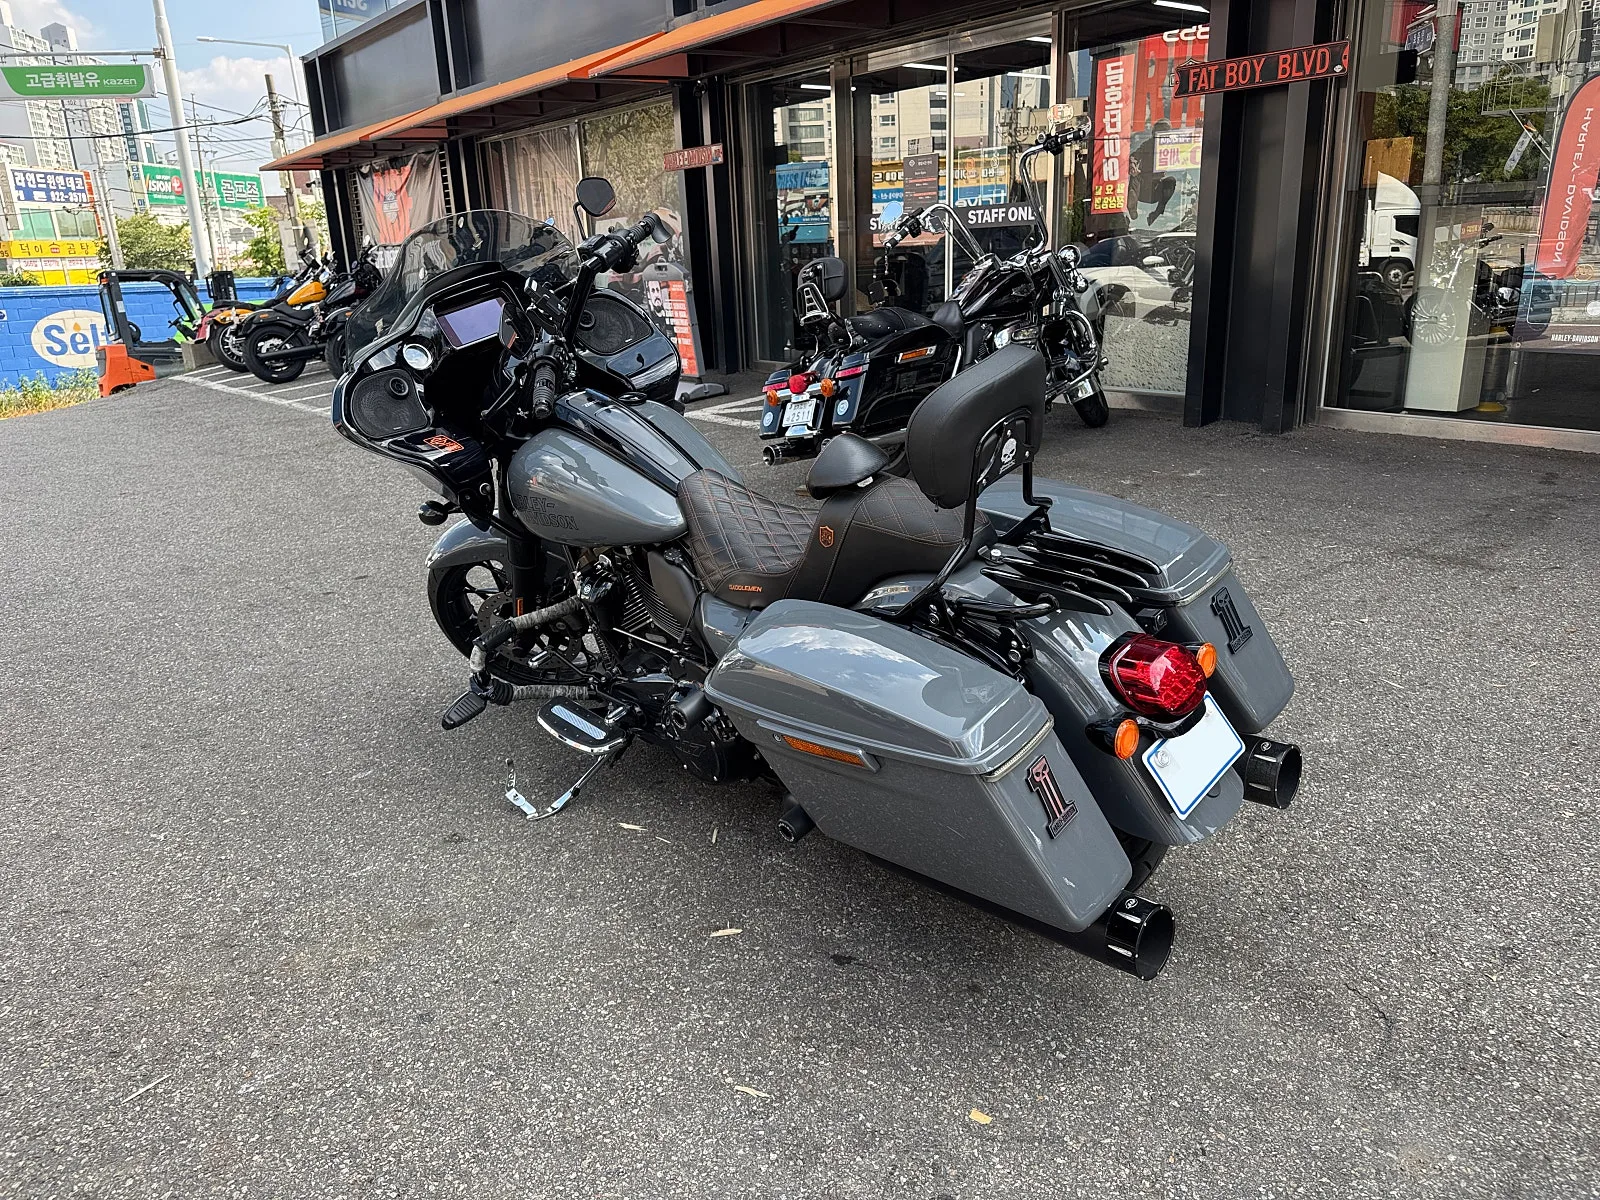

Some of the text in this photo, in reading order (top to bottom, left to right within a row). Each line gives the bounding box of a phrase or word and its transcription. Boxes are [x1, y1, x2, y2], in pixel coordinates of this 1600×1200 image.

[25, 71, 101, 88] 고급휘발유
[1188, 47, 1330, 92] FAT BOY BLVD
[221, 178, 260, 204] 골프존
[968, 205, 1036, 224] STAFF ONL
